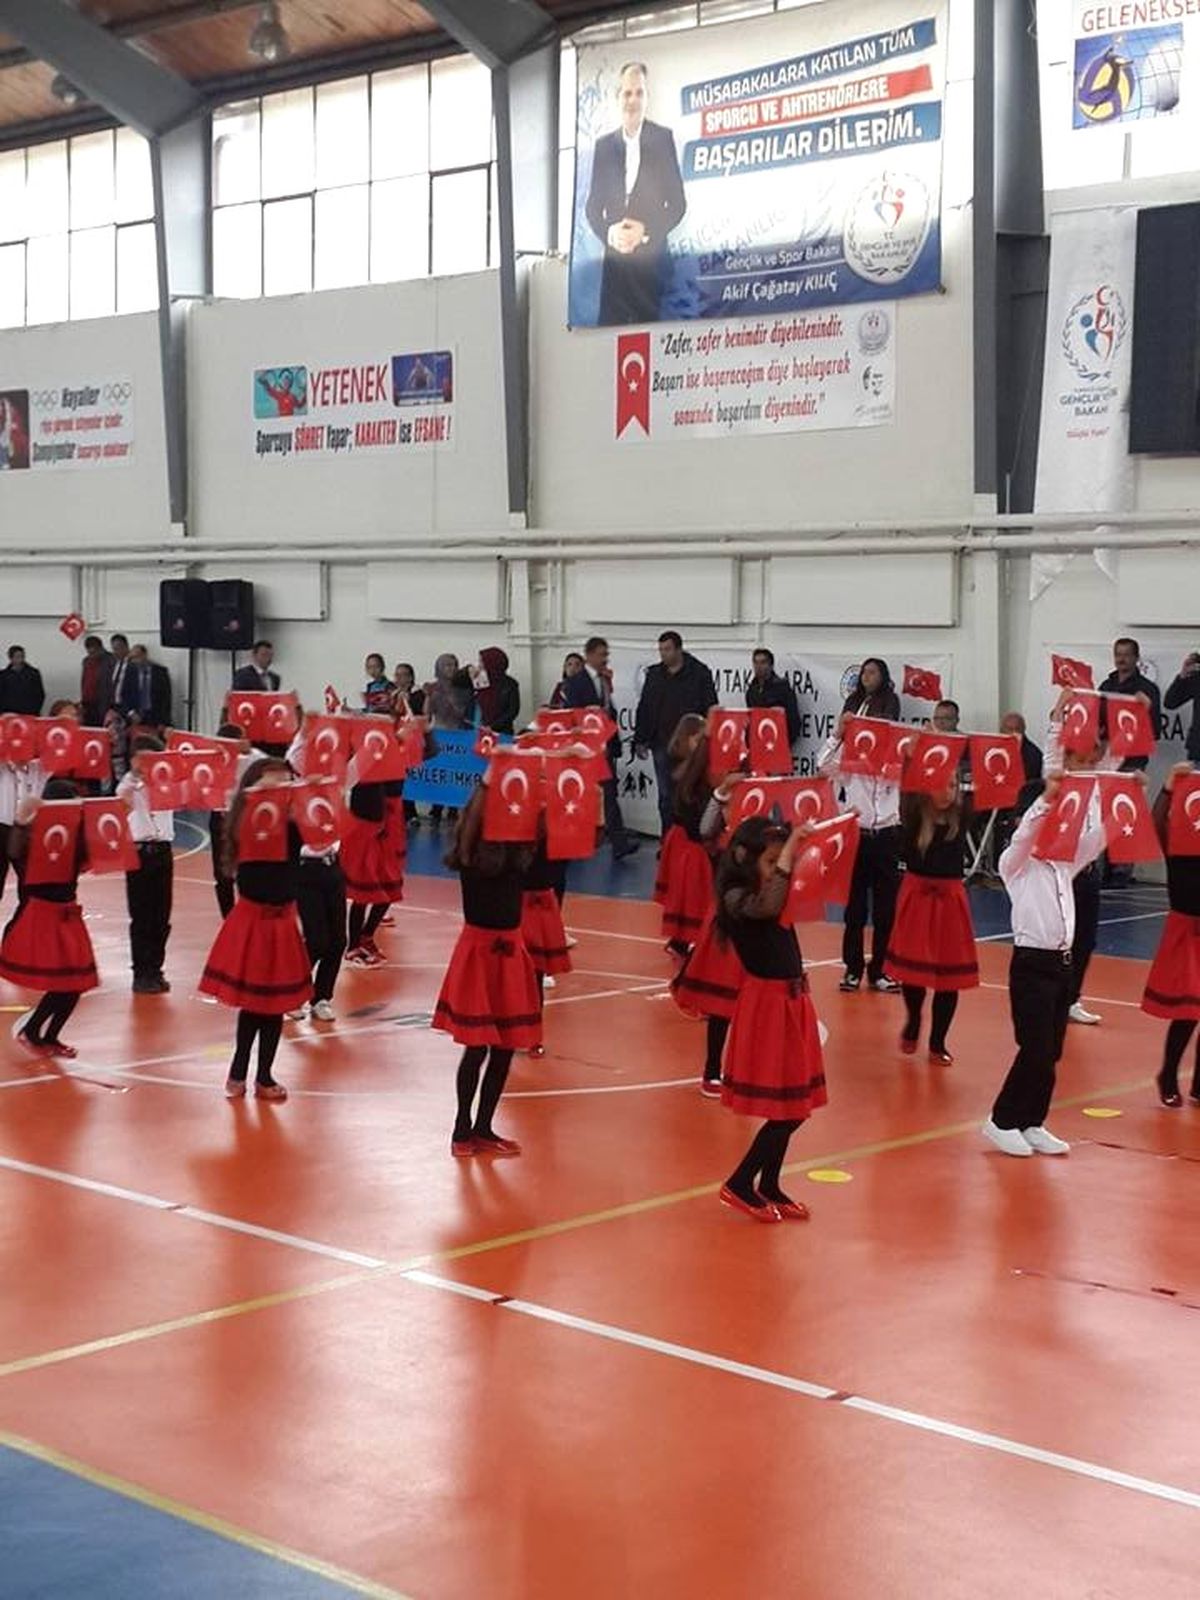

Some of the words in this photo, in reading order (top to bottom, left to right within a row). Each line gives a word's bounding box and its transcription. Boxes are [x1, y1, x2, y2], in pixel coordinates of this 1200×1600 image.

[1082, 0, 1200, 32] GELENEKSE
[690, 66, 808, 108] MÜSABAKALARA
[811, 46, 877, 75] KATILAN
[880, 29, 915, 51] TÜM
[705, 101, 759, 133] SPORCU
[761, 99, 779, 121] VE
[693, 135, 812, 177] BAŞARILAR
[818, 110, 923, 152] DİLERİM.
[725, 252, 763, 271] Gençlik
[765, 252, 778, 267] ve
[779, 250, 804, 266] Spor
[806, 245, 841, 261] Bakanı
[722, 284, 751, 301] Akif
[752, 279, 802, 300] Çağatay
[804, 272, 838, 292] KILIÇ
[697, 327, 721, 356] zafer
[724, 322, 768, 350] benimdir
[770, 314, 844, 348] diyebilenindir.
[310, 363, 388, 407] YETENEK
[652, 369, 684, 397] Başarı
[686, 366, 701, 388] ise
[767, 358, 789, 386] diye
[792, 350, 851, 382] başlayarak
[674, 403, 714, 427] sonunda
[716, 398, 761, 429] başardım
[355, 419, 397, 446] KARAKTER
[400, 416, 413, 443] ise
[414, 415, 446, 443] EFSANE
[814, 715, 834, 739] VE
